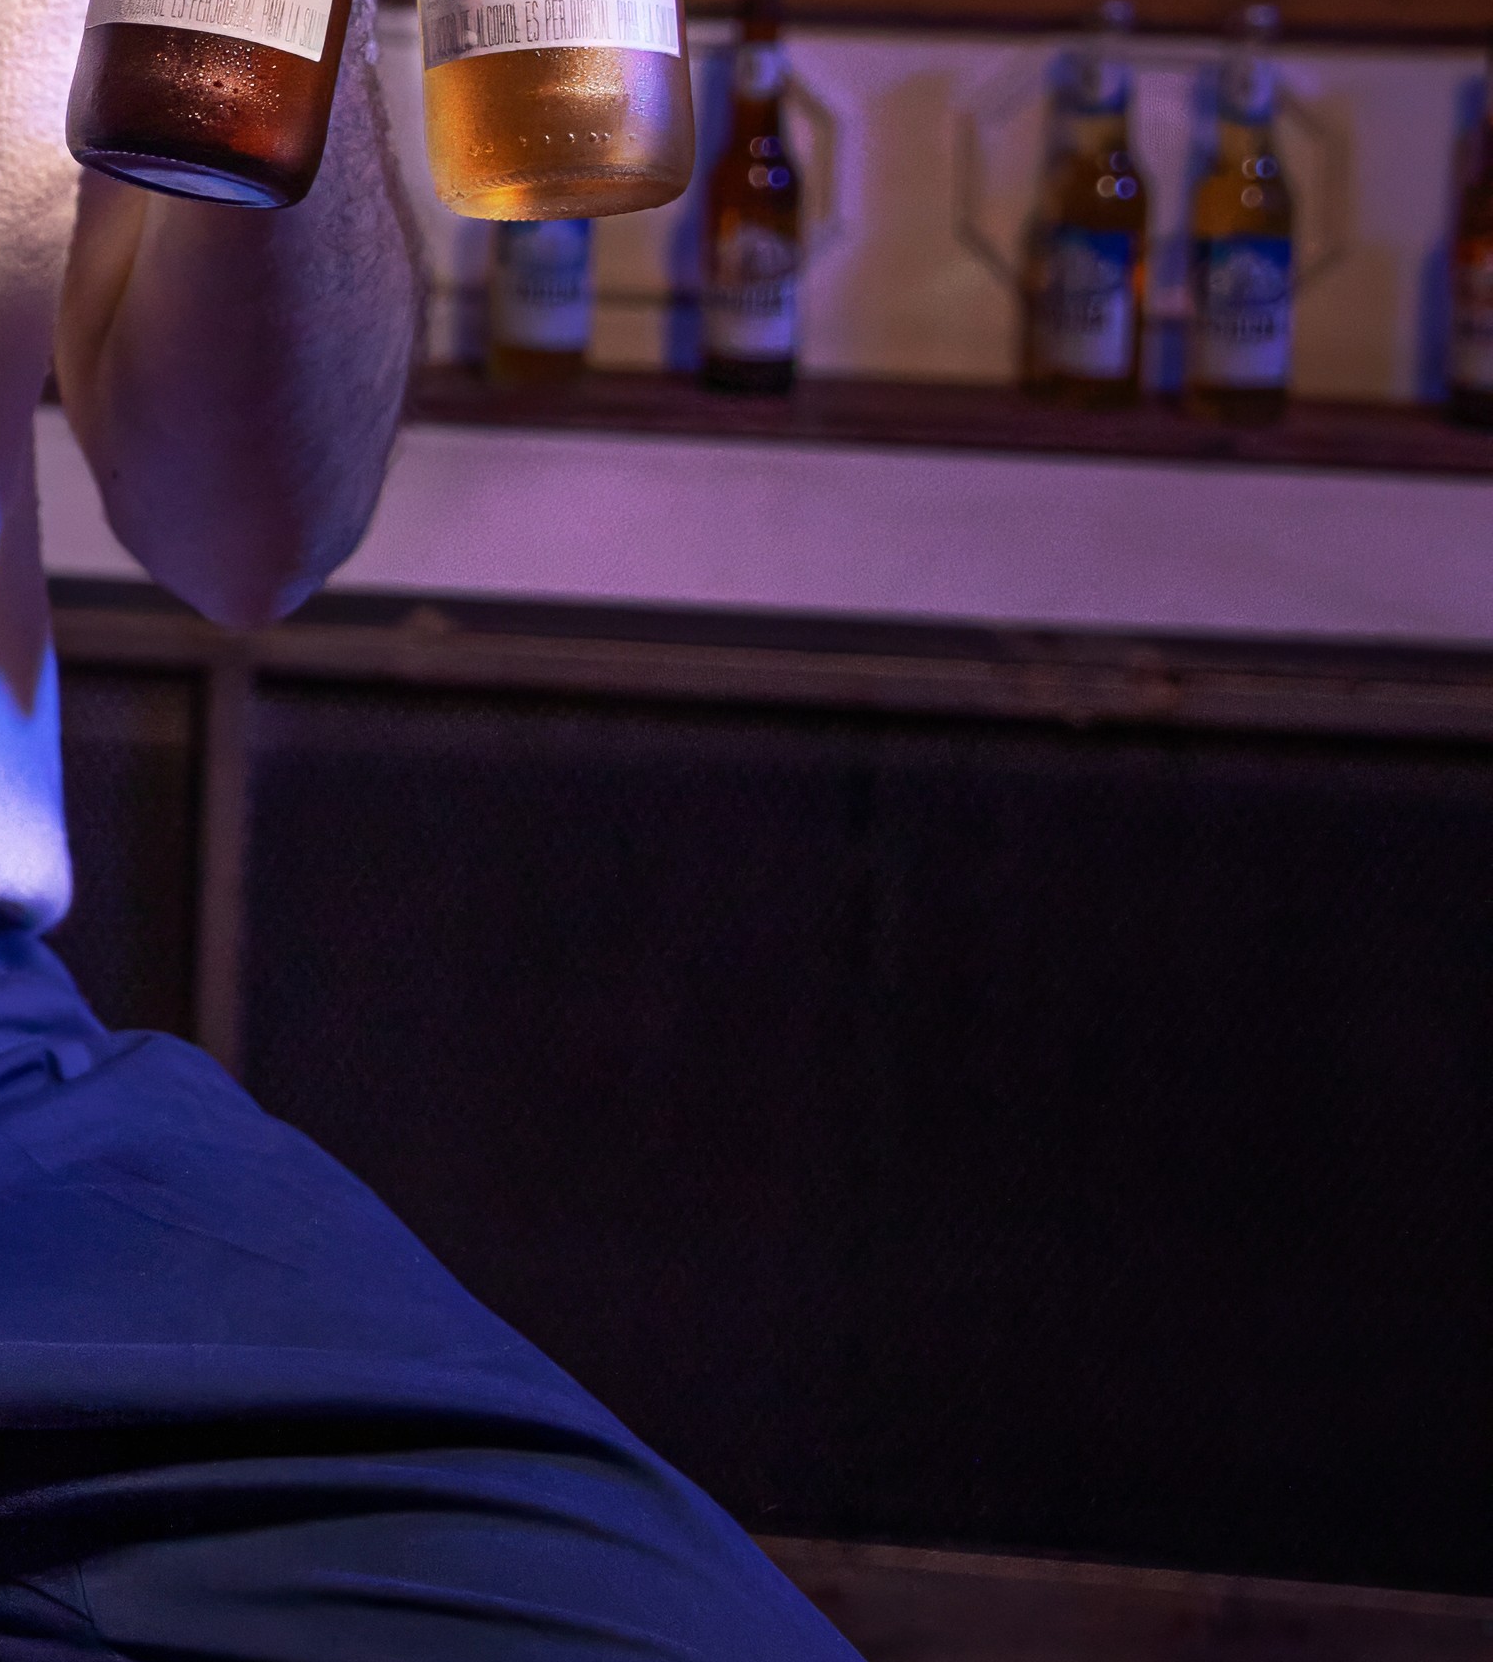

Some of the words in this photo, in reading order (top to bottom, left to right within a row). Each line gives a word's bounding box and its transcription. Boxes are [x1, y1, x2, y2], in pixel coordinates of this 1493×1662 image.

[285, 0, 301, 44] LA
[475, 4, 521, 48] ALCOHOL
[525, 0, 540, 42] ES
